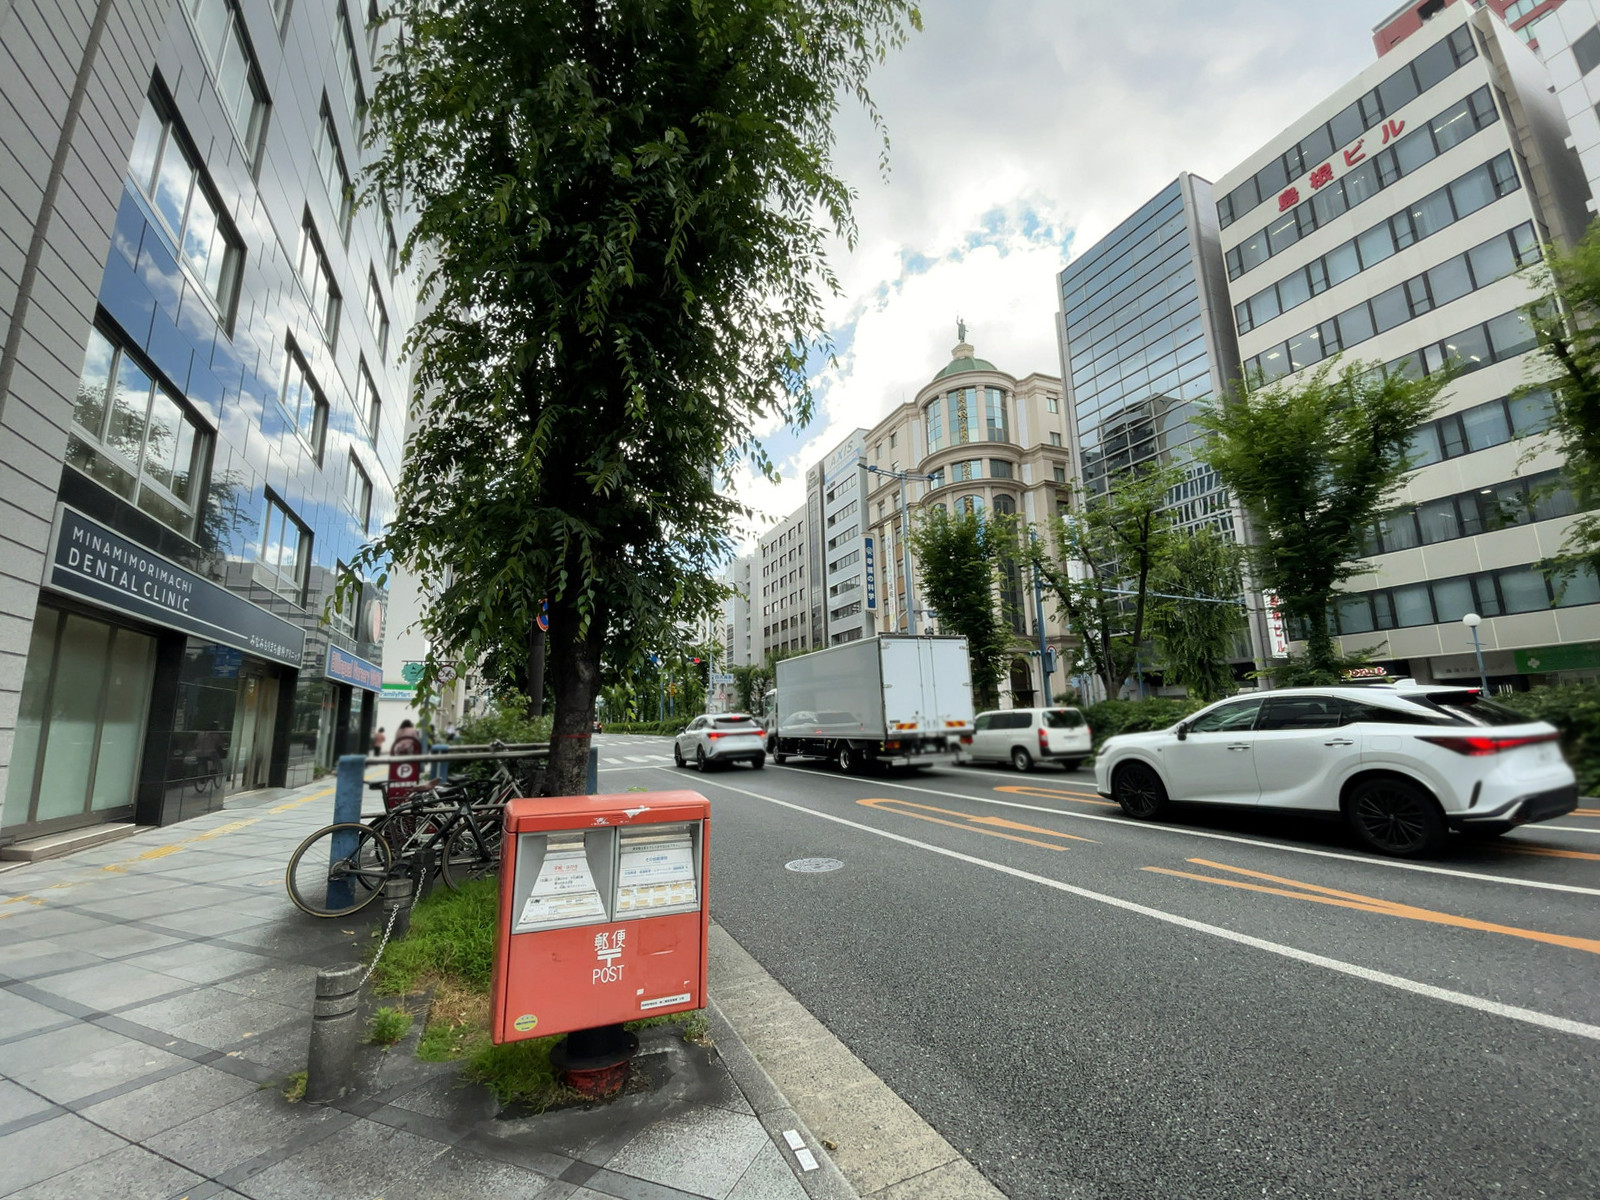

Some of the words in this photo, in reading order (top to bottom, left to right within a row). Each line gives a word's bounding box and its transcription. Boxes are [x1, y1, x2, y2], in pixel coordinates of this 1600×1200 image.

[1278, 120, 1405, 212] 島根ビル
[830, 440, 853, 468] AXIS
[72, 526, 193, 594] MINAMIMORIMACHI
[68, 547, 138, 592] DENTAL
[143, 581, 190, 612] CLINIC
[400, 766, 410, 777] P
[594, 929, 626, 951] 郵便
[592, 965, 625, 985] POST
